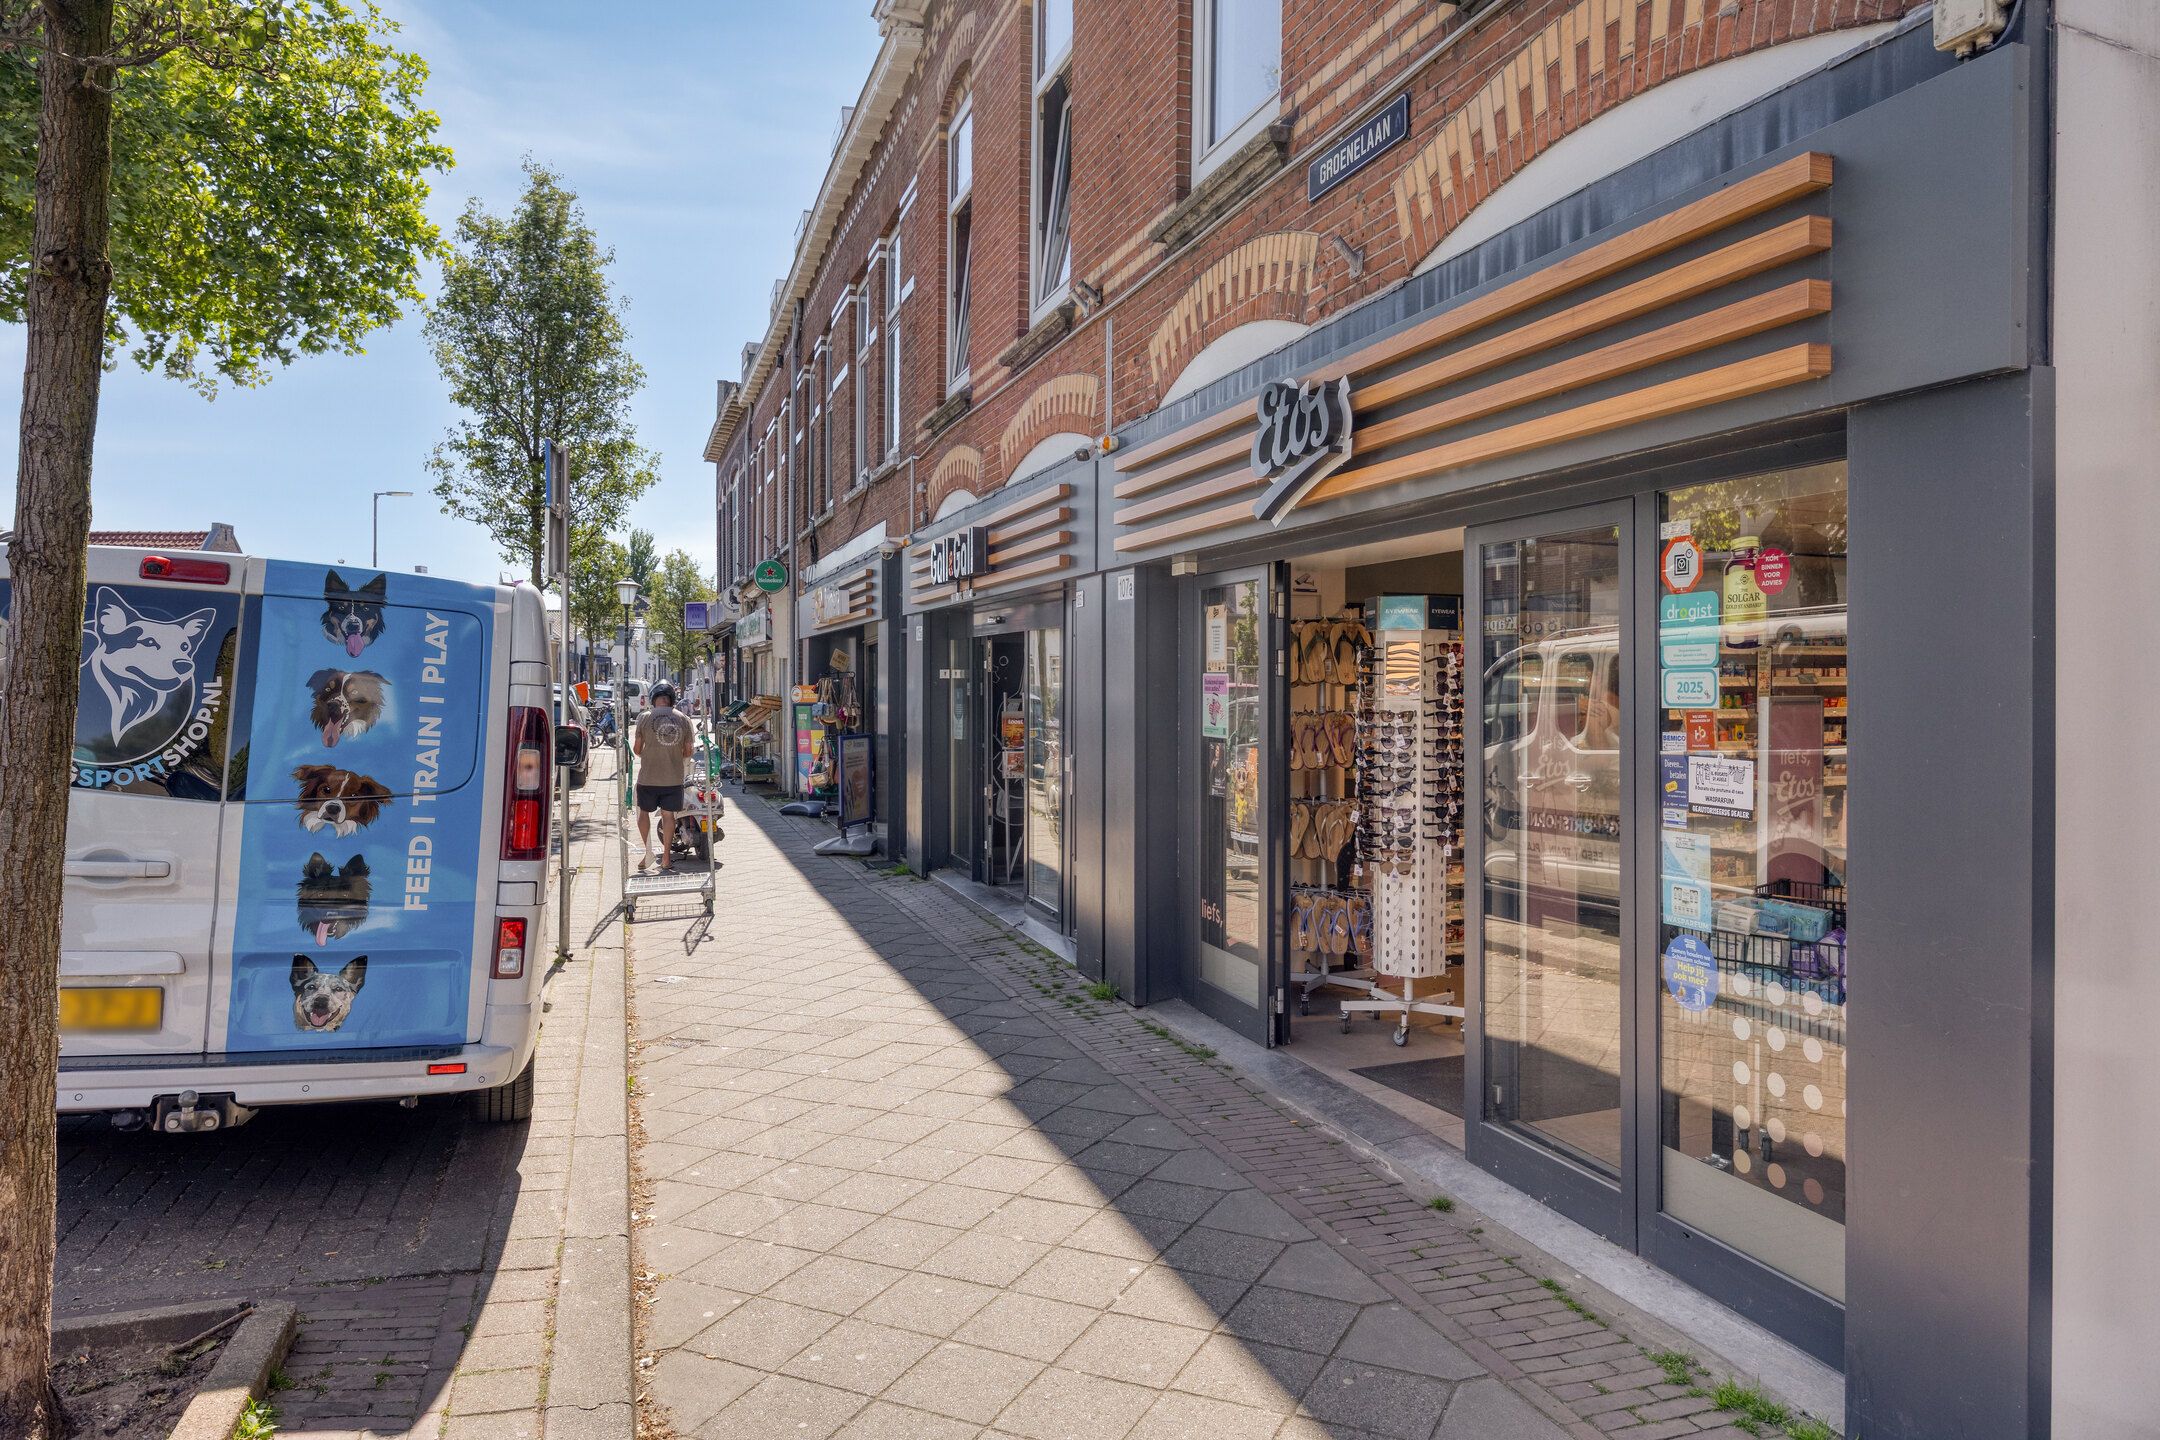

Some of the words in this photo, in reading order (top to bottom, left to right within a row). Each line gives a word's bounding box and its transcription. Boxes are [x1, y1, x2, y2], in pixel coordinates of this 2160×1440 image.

[1320, 115, 1391, 185] GROENELAAN
[1251, 376, 1345, 485] Etos
[931, 538, 948, 585] Gall
[954, 527, 973, 578] Gall
[1727, 592, 1761, 603] SOLGAR
[1667, 602, 1712, 621] drogist
[422, 611, 449, 684] PLAY
[1677, 681, 1703, 693] 2025
[412, 716, 442, 806] TRAIN
[1776, 771, 1815, 801] Etos
[1731, 809, 1750, 819] DEALER
[404, 836, 433, 911] FEED
[1201, 898, 1223, 928] liefs,
[1687, 950, 1703, 960] houden
[1694, 958, 1711, 968] schoon
[1673, 971, 1687, 982] ook
[1688, 975, 1709, 987] mee?
[1677, 960, 1695, 975] Help
[1696, 965, 1704, 978] jij
